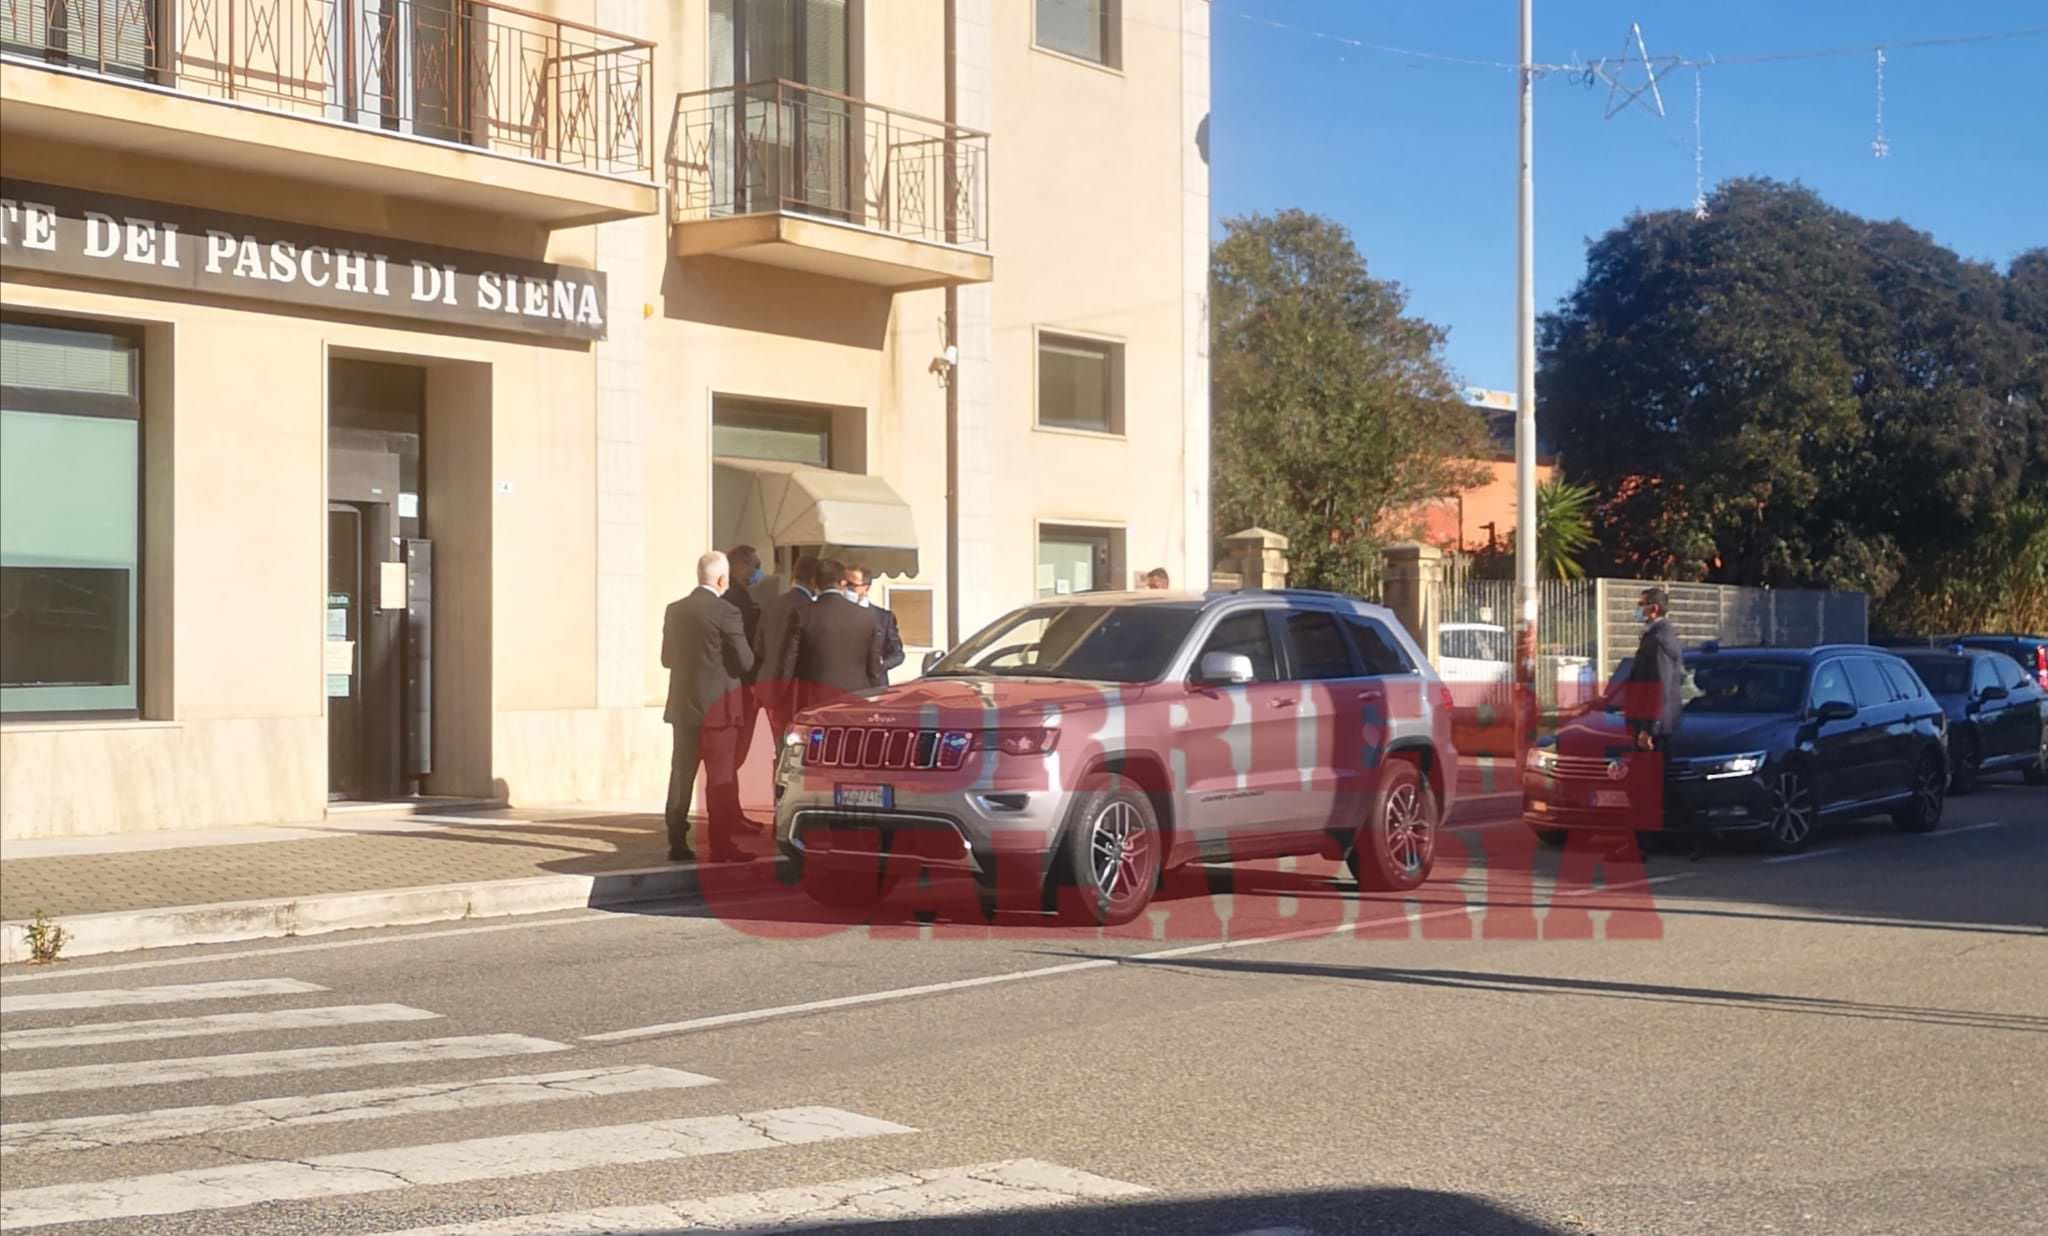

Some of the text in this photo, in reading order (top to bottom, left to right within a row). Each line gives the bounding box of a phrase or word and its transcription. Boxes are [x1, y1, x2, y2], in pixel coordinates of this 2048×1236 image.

[83, 210, 180, 268] DEI
[205, 228, 390, 296] PASCHI
[411, 260, 458, 306] DI
[478, 271, 603, 325] SIENA
